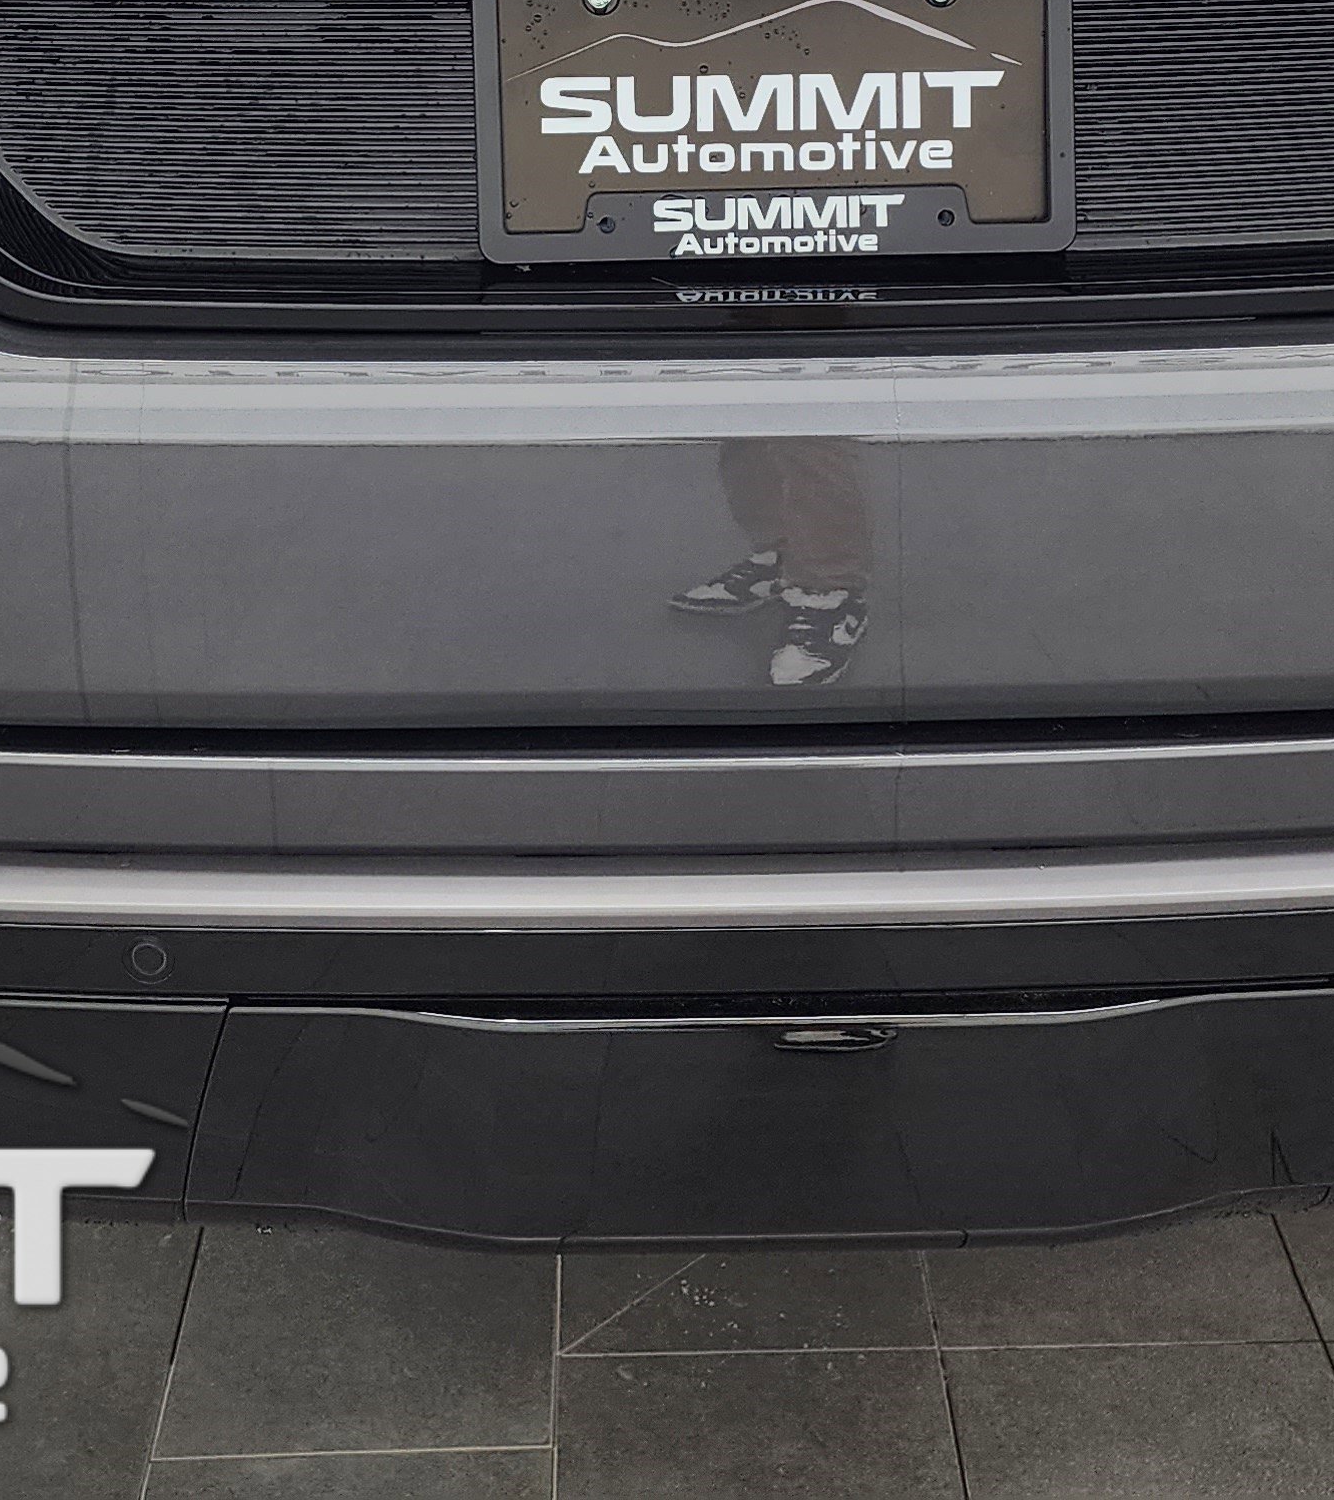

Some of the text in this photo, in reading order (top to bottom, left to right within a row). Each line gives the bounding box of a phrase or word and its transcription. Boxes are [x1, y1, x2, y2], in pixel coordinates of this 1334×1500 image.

[540, 70, 1005, 135] SUMMIT
[578, 130, 954, 174] Automotive
[652, 193, 906, 233] SUMMIT
[673, 229, 879, 257] Automotive
